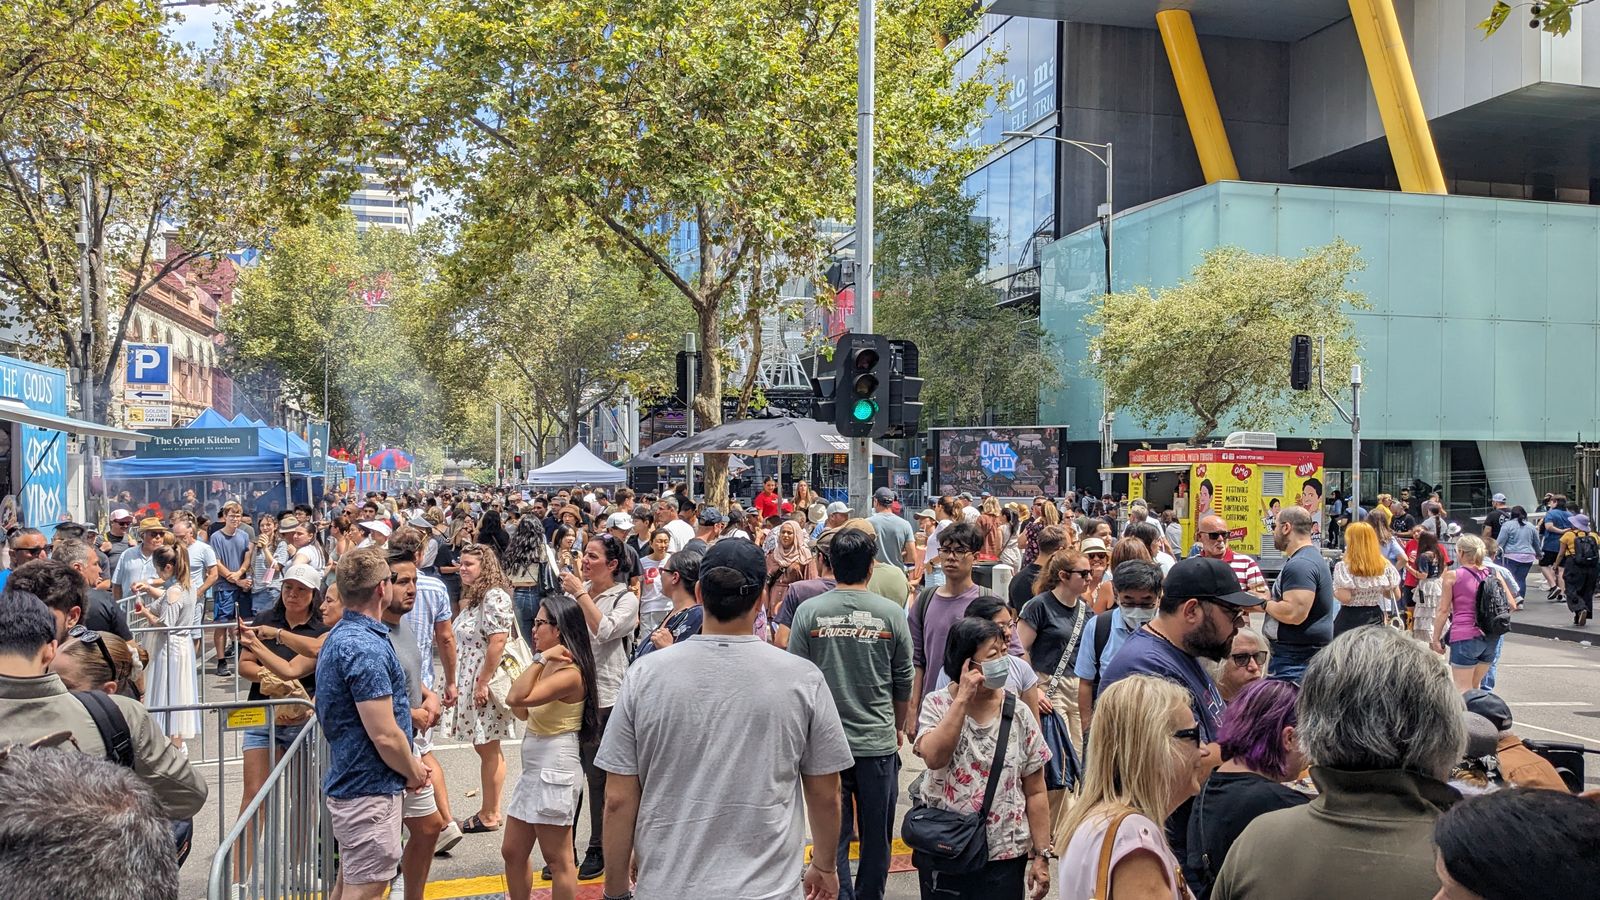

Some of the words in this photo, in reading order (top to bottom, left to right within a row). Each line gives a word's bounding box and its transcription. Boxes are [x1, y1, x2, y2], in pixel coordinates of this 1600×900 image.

[135, 349, 160, 378] P
[23, 371, 52, 404] GODS
[155, 436, 172, 445] The
[173, 436, 205, 446] Cypriot
[207, 436, 240, 444] Kitchen
[981, 441, 1011, 457] ONLY
[26, 436, 61, 476] GREEK
[912, 460, 918, 468] P
[992, 457, 1018, 473] CITY
[1298, 462, 1315, 475] YUM
[1225, 485, 1249, 493] FESTIVALS
[1225, 495, 1248, 503] MARKETS
[1225, 514, 1248, 522] CATERING
[1229, 530, 1244, 538] CALL
[818, 627, 857, 639] CRUISER
[858, 627, 881, 640] LIFE
